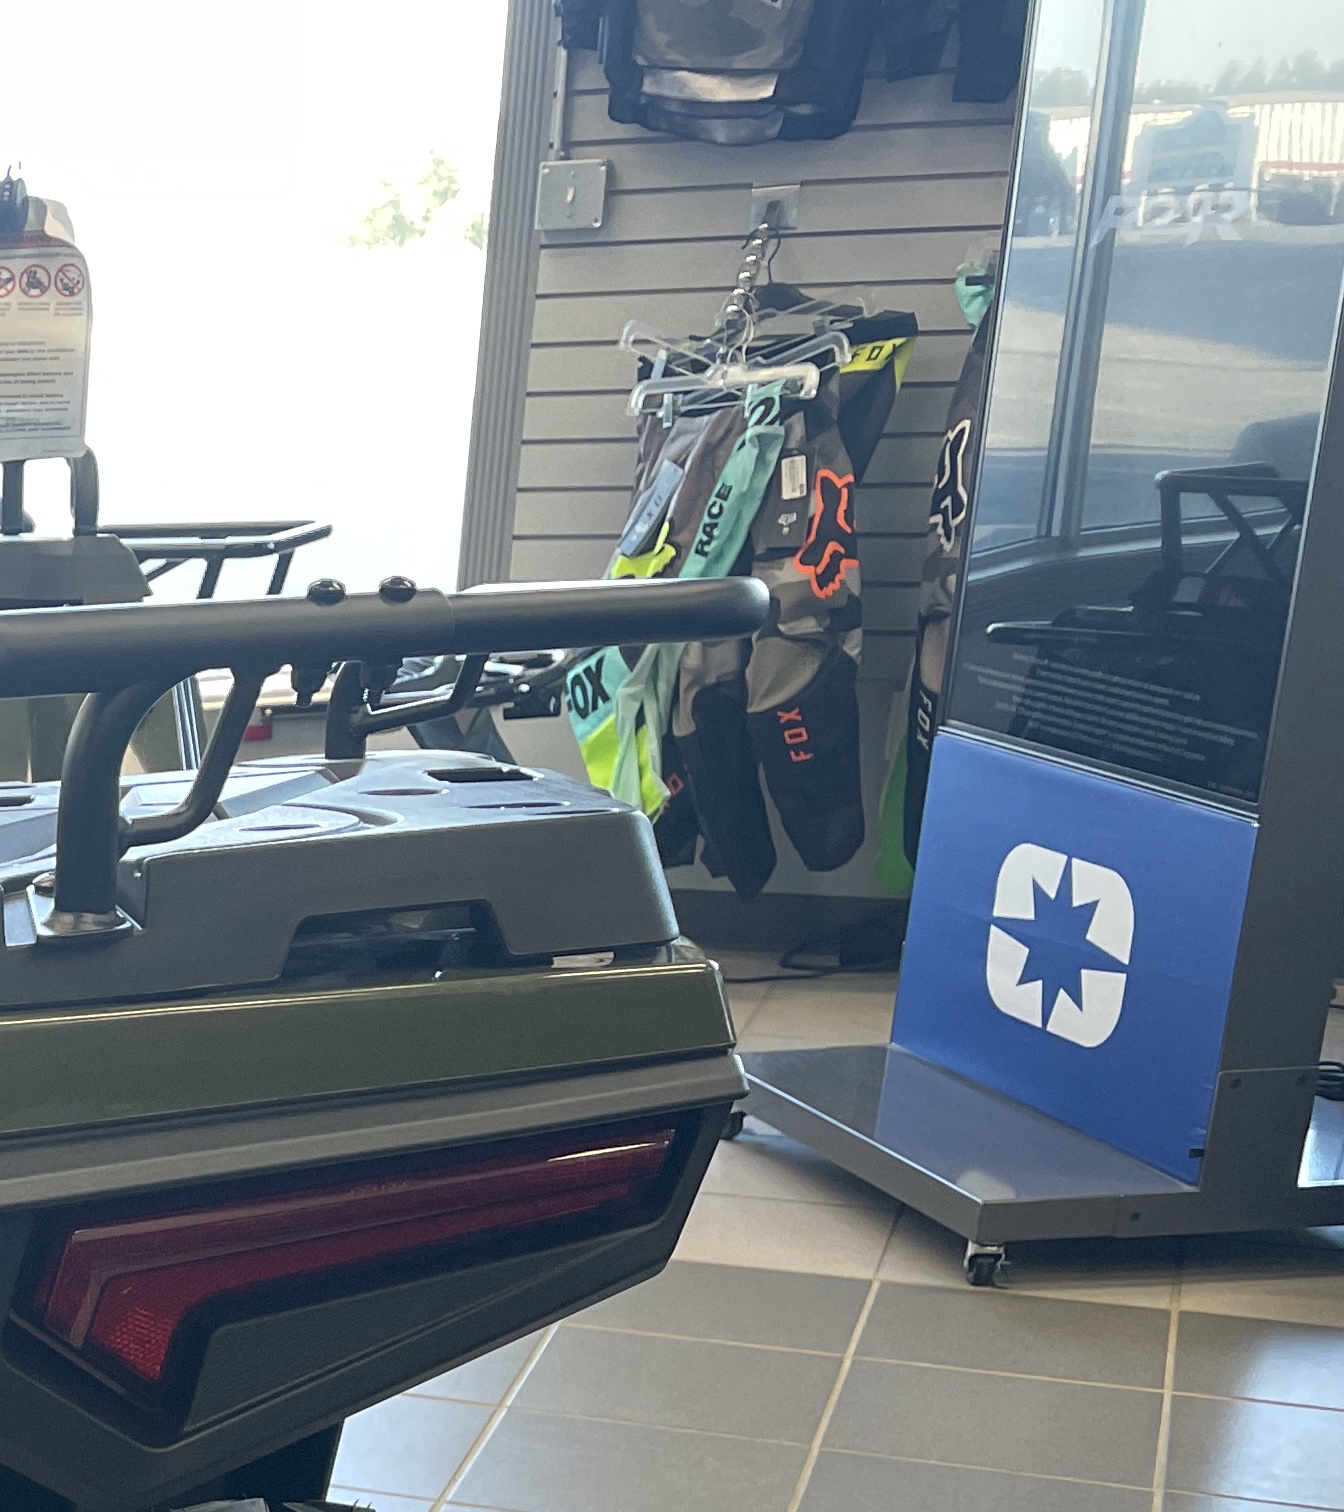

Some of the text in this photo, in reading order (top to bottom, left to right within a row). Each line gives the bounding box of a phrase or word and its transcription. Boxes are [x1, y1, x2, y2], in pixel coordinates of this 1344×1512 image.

[694, 482, 733, 557] RACE
[564, 656, 610, 720] OX
[777, 706, 814, 763] FOX
